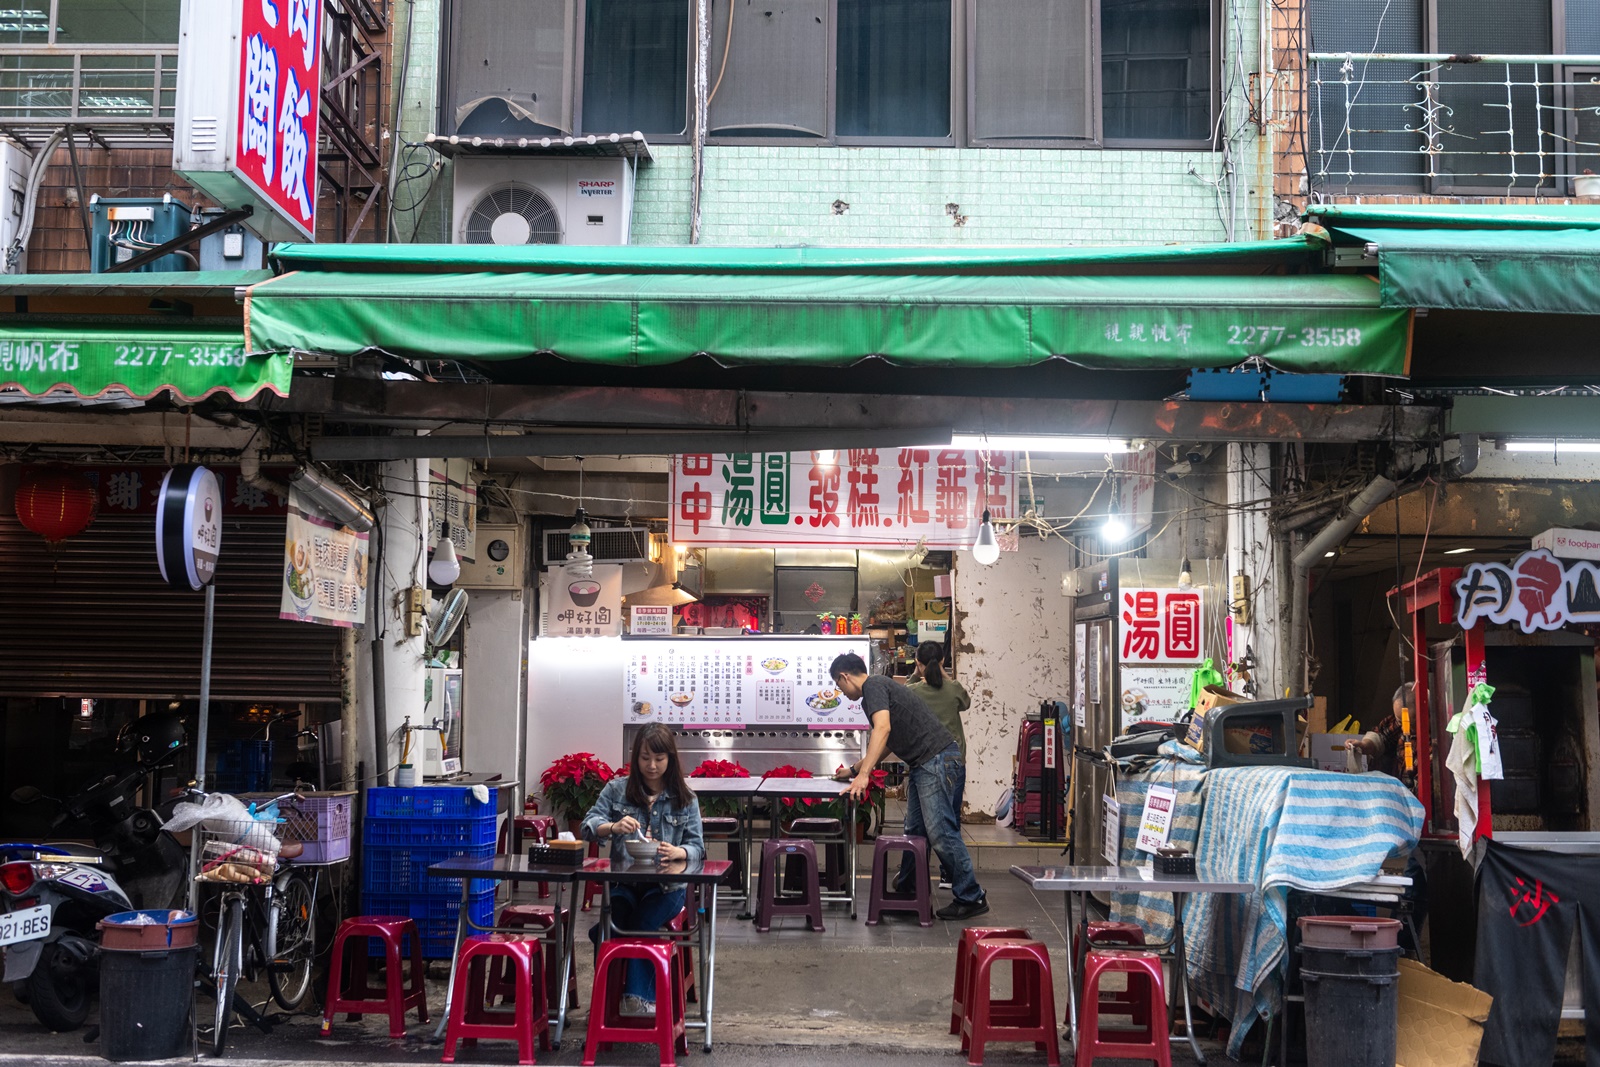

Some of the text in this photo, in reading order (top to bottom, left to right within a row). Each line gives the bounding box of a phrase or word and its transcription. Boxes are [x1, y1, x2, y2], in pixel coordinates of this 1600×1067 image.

[1227, 325, 1361, 347] 2277-3558
[114, 345, 246, 368] 2277-3558
[1122, 591, 1200, 660] 湯圓
